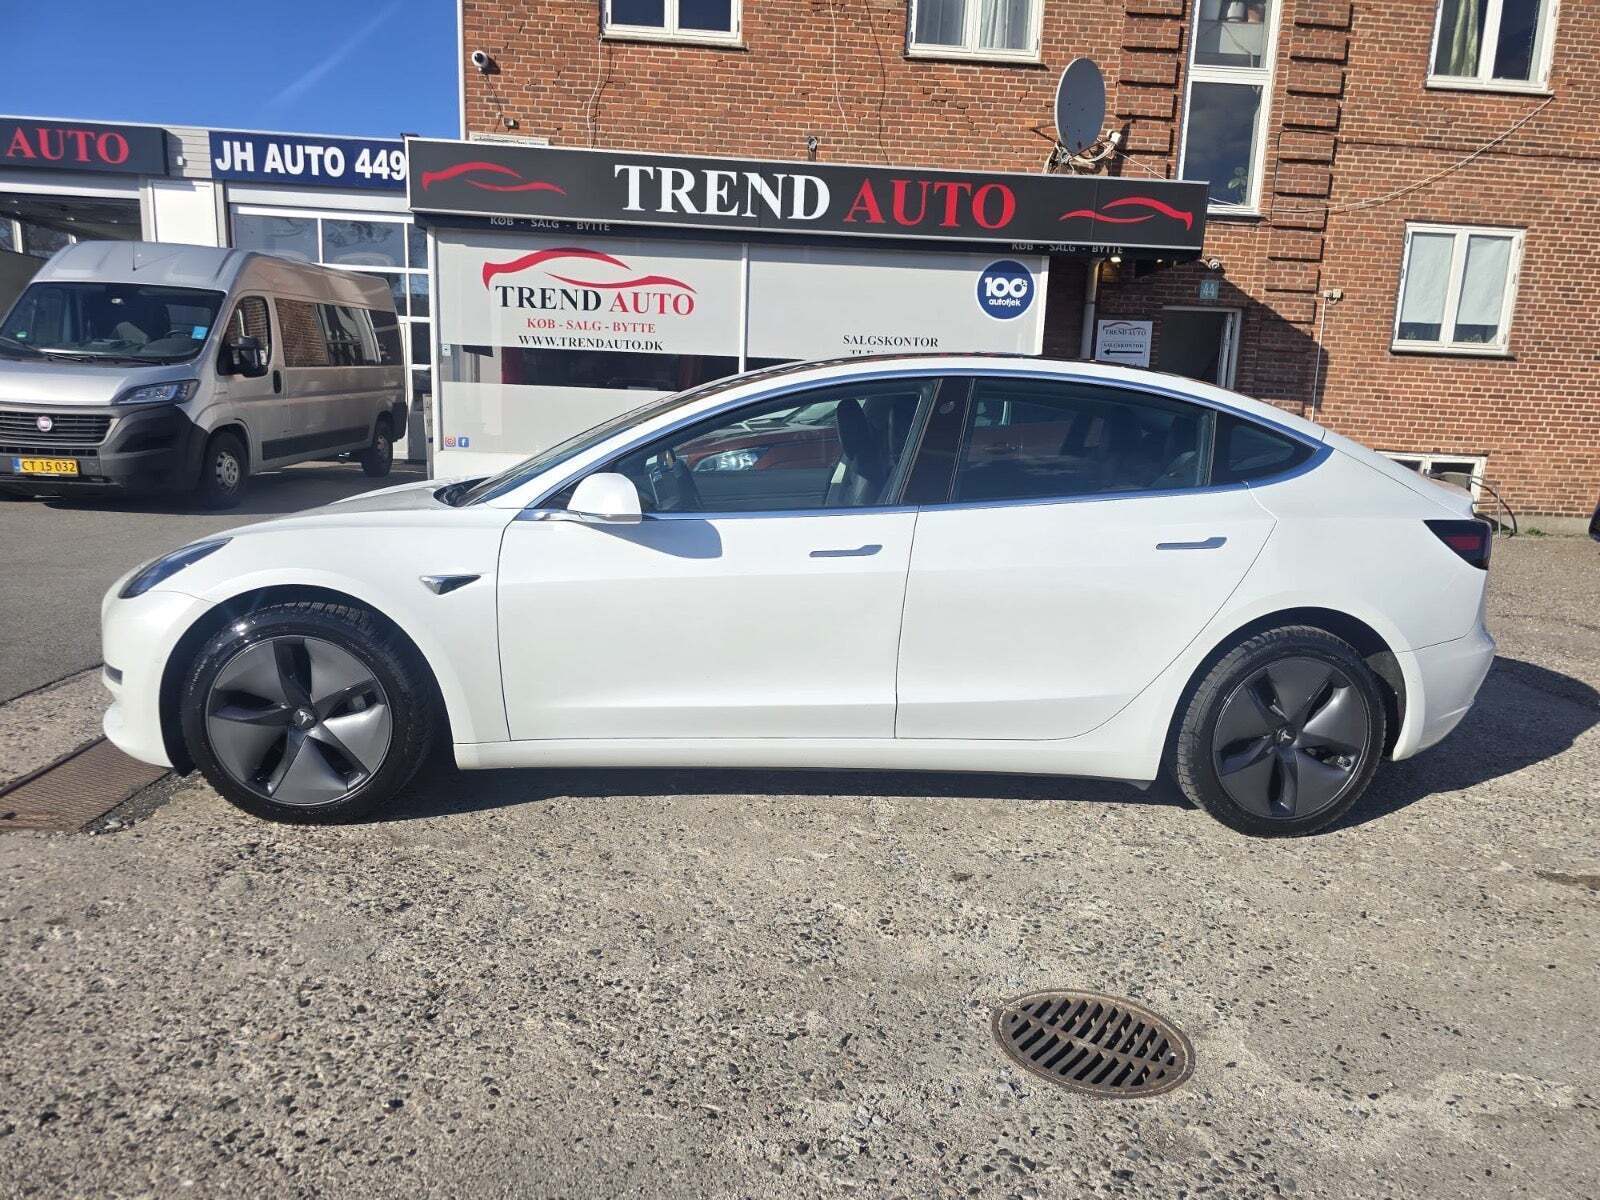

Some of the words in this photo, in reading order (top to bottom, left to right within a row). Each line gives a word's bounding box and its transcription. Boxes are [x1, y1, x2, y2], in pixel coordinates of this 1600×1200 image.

[6, 127, 129, 164] AUTO
[215, 140, 254, 171] JH
[264, 143, 345, 177] AUTO
[355, 148, 407, 181] 449
[614, 163, 831, 220] TREND
[843, 178, 1016, 229] AUTO
[490, 215, 514, 226] KØB
[530, 219, 559, 229] SALG
[577, 221, 610, 231] BYTTE
[495, 285, 602, 312] TREND
[609, 291, 695, 316] AUTO
[527, 318, 555, 329] KØB
[566, 319, 602, 331] SALG
[612, 321, 656, 333] BYTTE
[518, 335, 664, 351] WWW.TRENDAUTO.DK
[843, 334, 938, 347] SALGSKONTOR
[22, 461, 36, 471] CT
[41, 461, 52, 472] 15
[55, 463, 77, 473] 032
